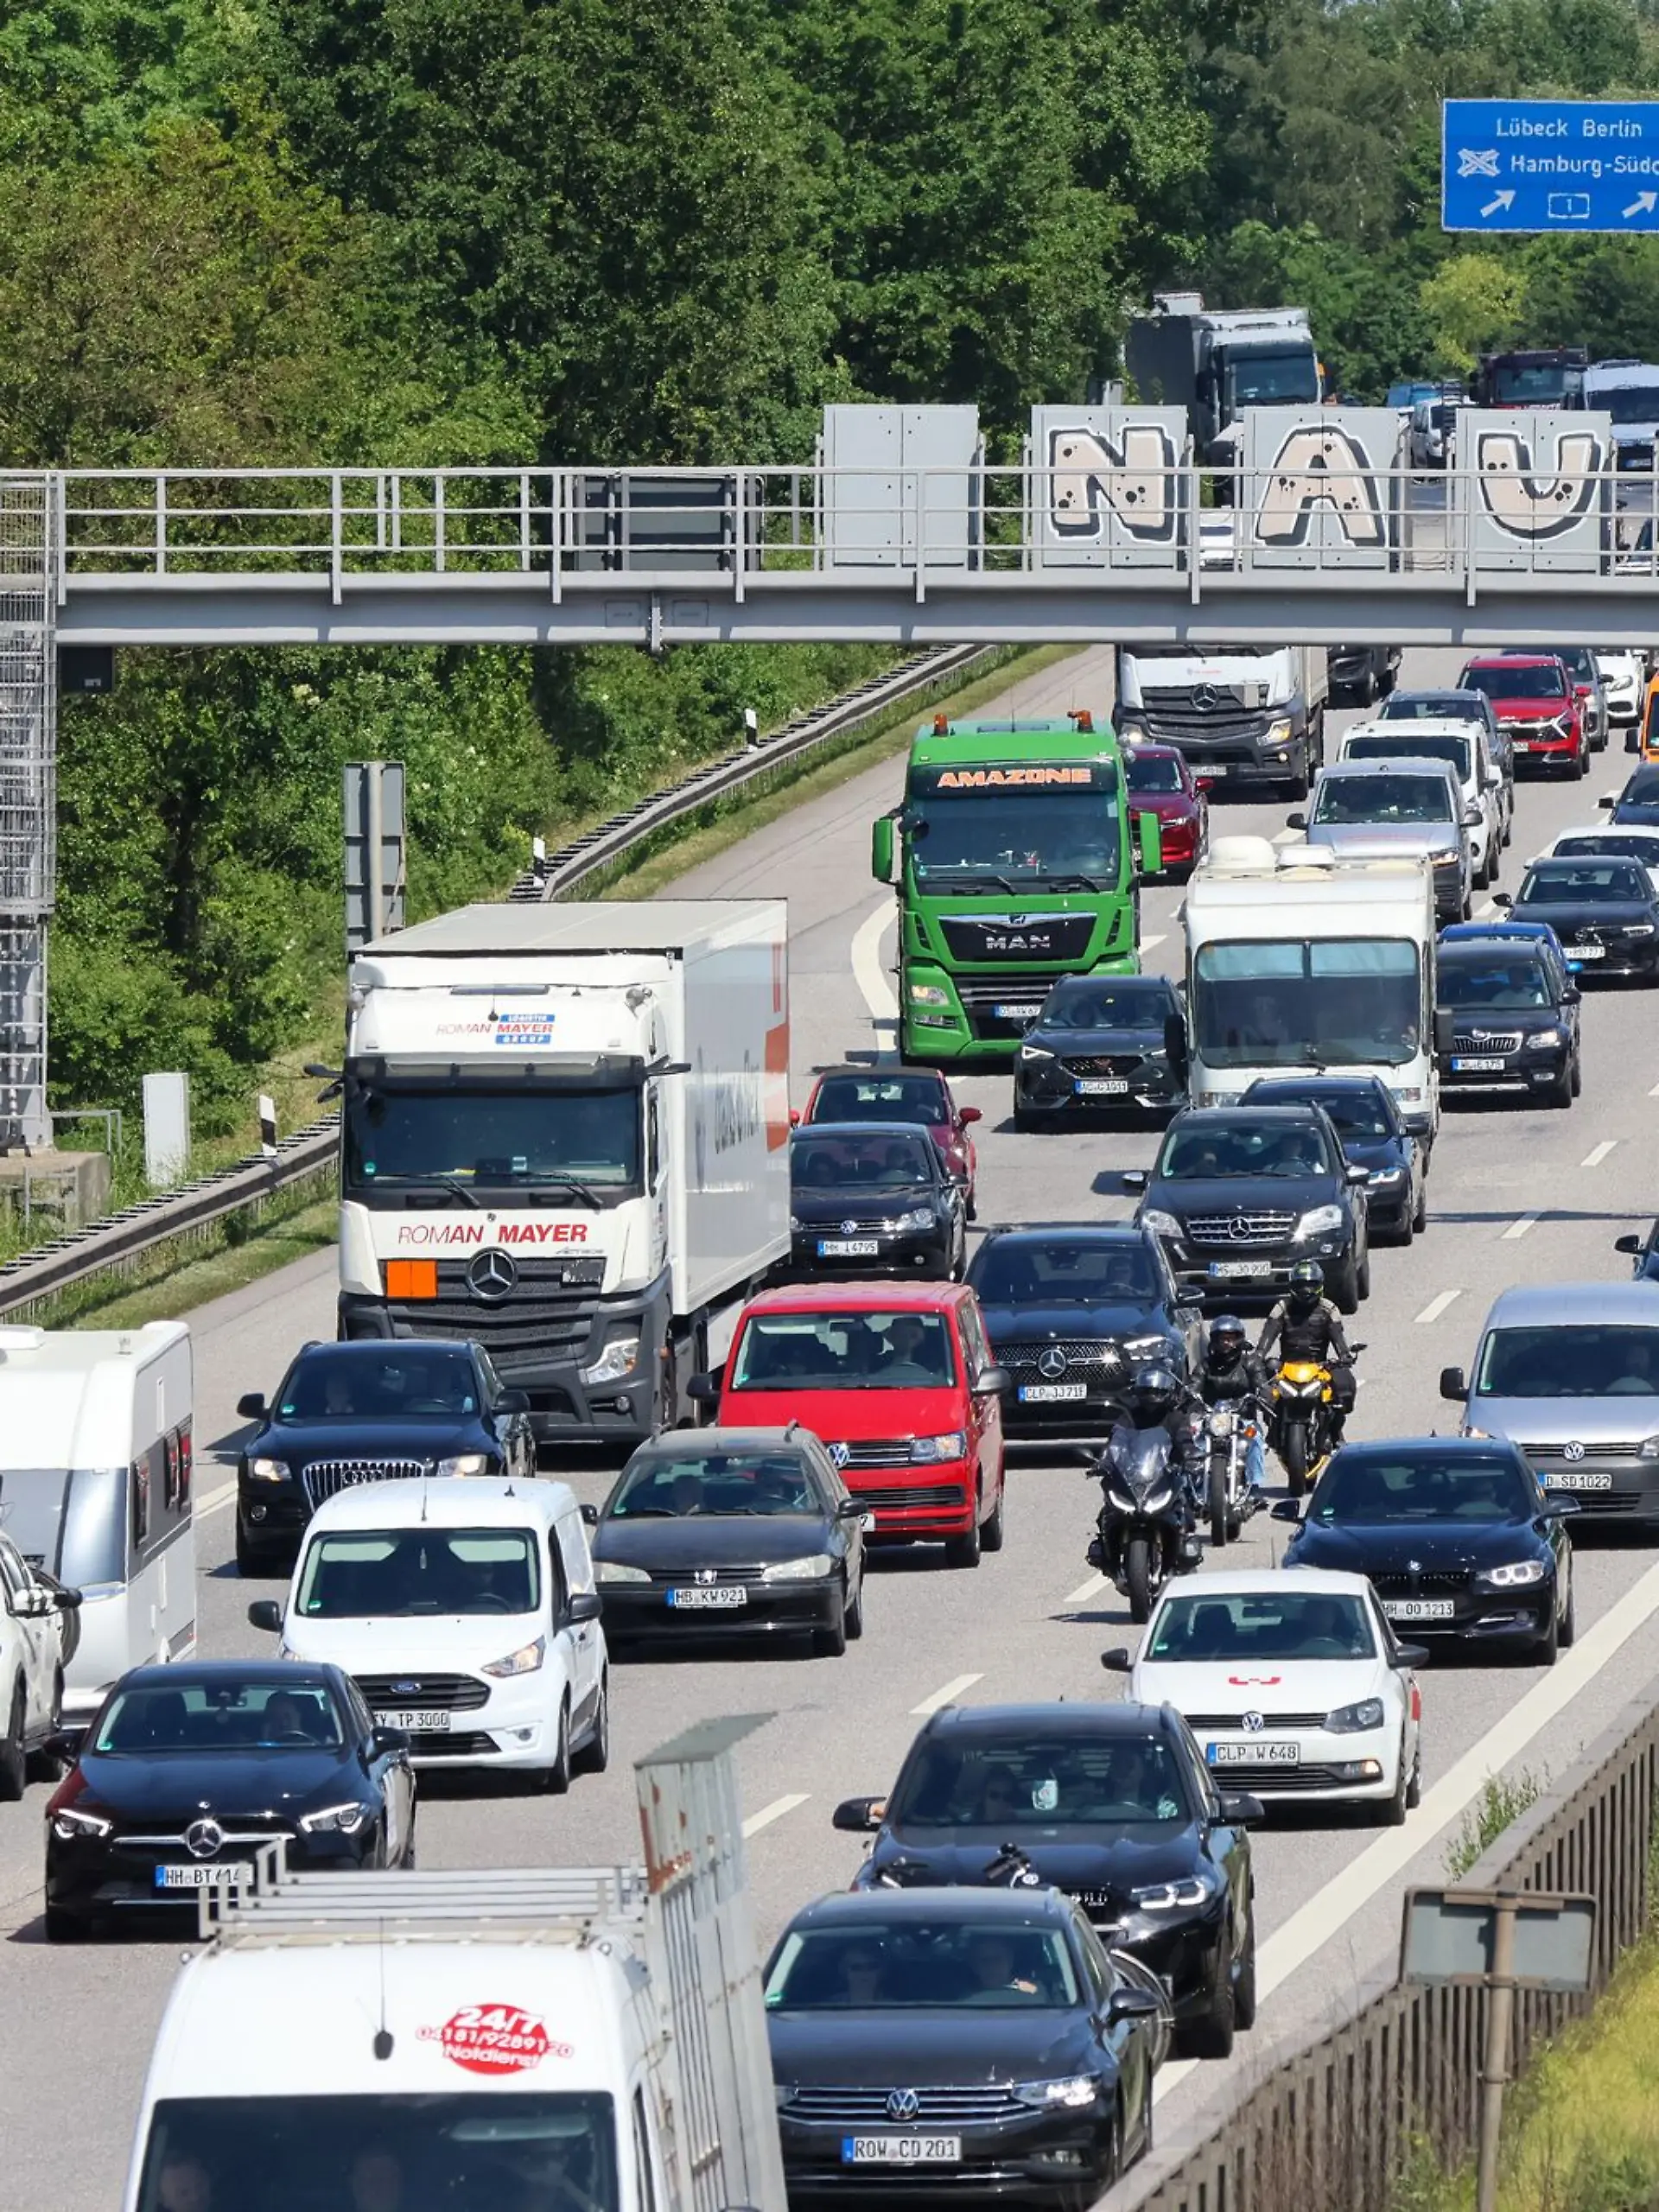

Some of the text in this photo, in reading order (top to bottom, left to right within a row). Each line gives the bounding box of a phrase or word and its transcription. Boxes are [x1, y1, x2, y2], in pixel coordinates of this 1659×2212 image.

[1497, 118, 1643, 137] Lübeck Berlin
[1567, 199, 1573, 213] 1
[938, 768, 1090, 788] AMAZONE
[986, 935, 1051, 950] MAN
[497, 1024, 554, 1033] MAYER
[398, 1224, 588, 1244] ROMAN MAYER
[1217, 1746, 1246, 1760] CLP
[167, 1869, 183, 1884] HH
[454, 2005, 544, 2036] 24/7
[855, 2140, 887, 2158] ROW
